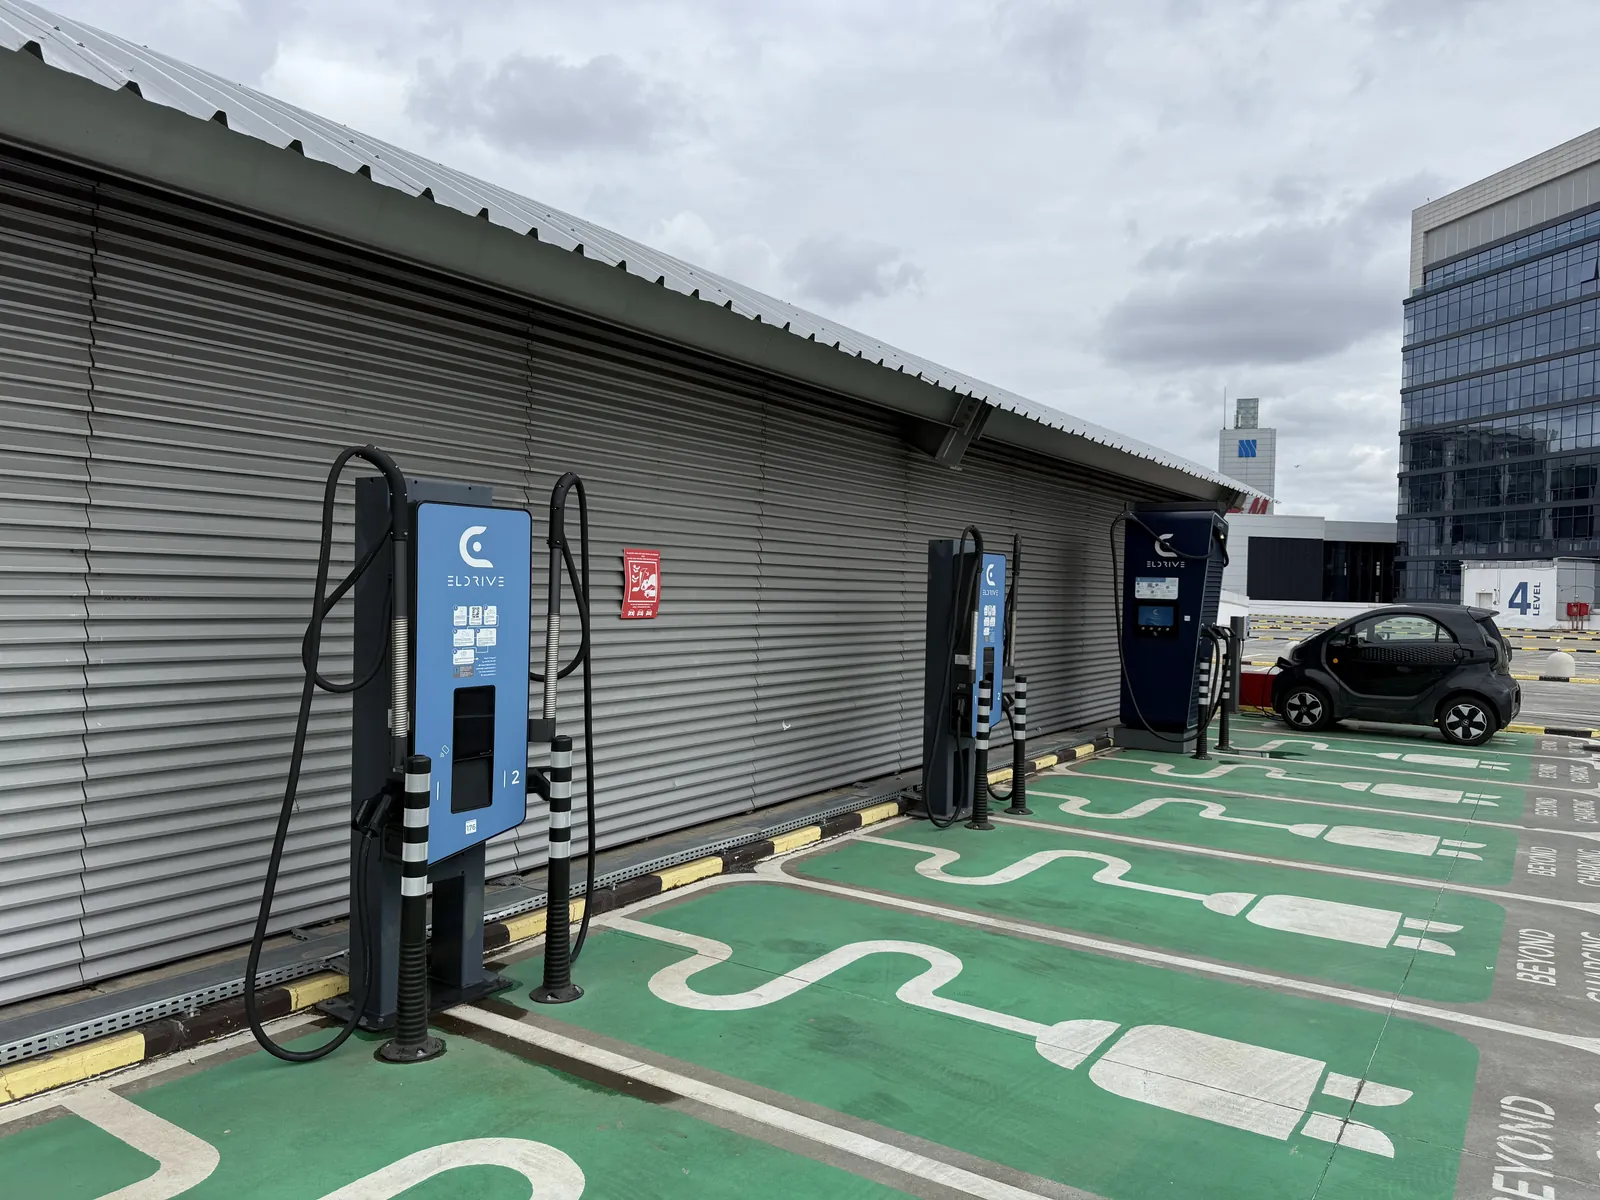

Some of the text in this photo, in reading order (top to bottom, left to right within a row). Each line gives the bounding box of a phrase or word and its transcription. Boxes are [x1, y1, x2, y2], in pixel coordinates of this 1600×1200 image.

[1146, 560, 1186, 568] ELDRIVE
[447, 575, 505, 587] ELDRIVE
[982, 589, 999, 597] ELDRIVE
[1508, 581, 1531, 615] 4
[1532, 581, 1541, 616] LEVEL
[511, 769, 520, 785] 2
[1534, 796, 1558, 817] BEYOND
[1527, 846, 1557, 877] BEYOND
[1516, 928, 1556, 986] BEYOND
[1492, 1096, 1555, 1200] EYOND
